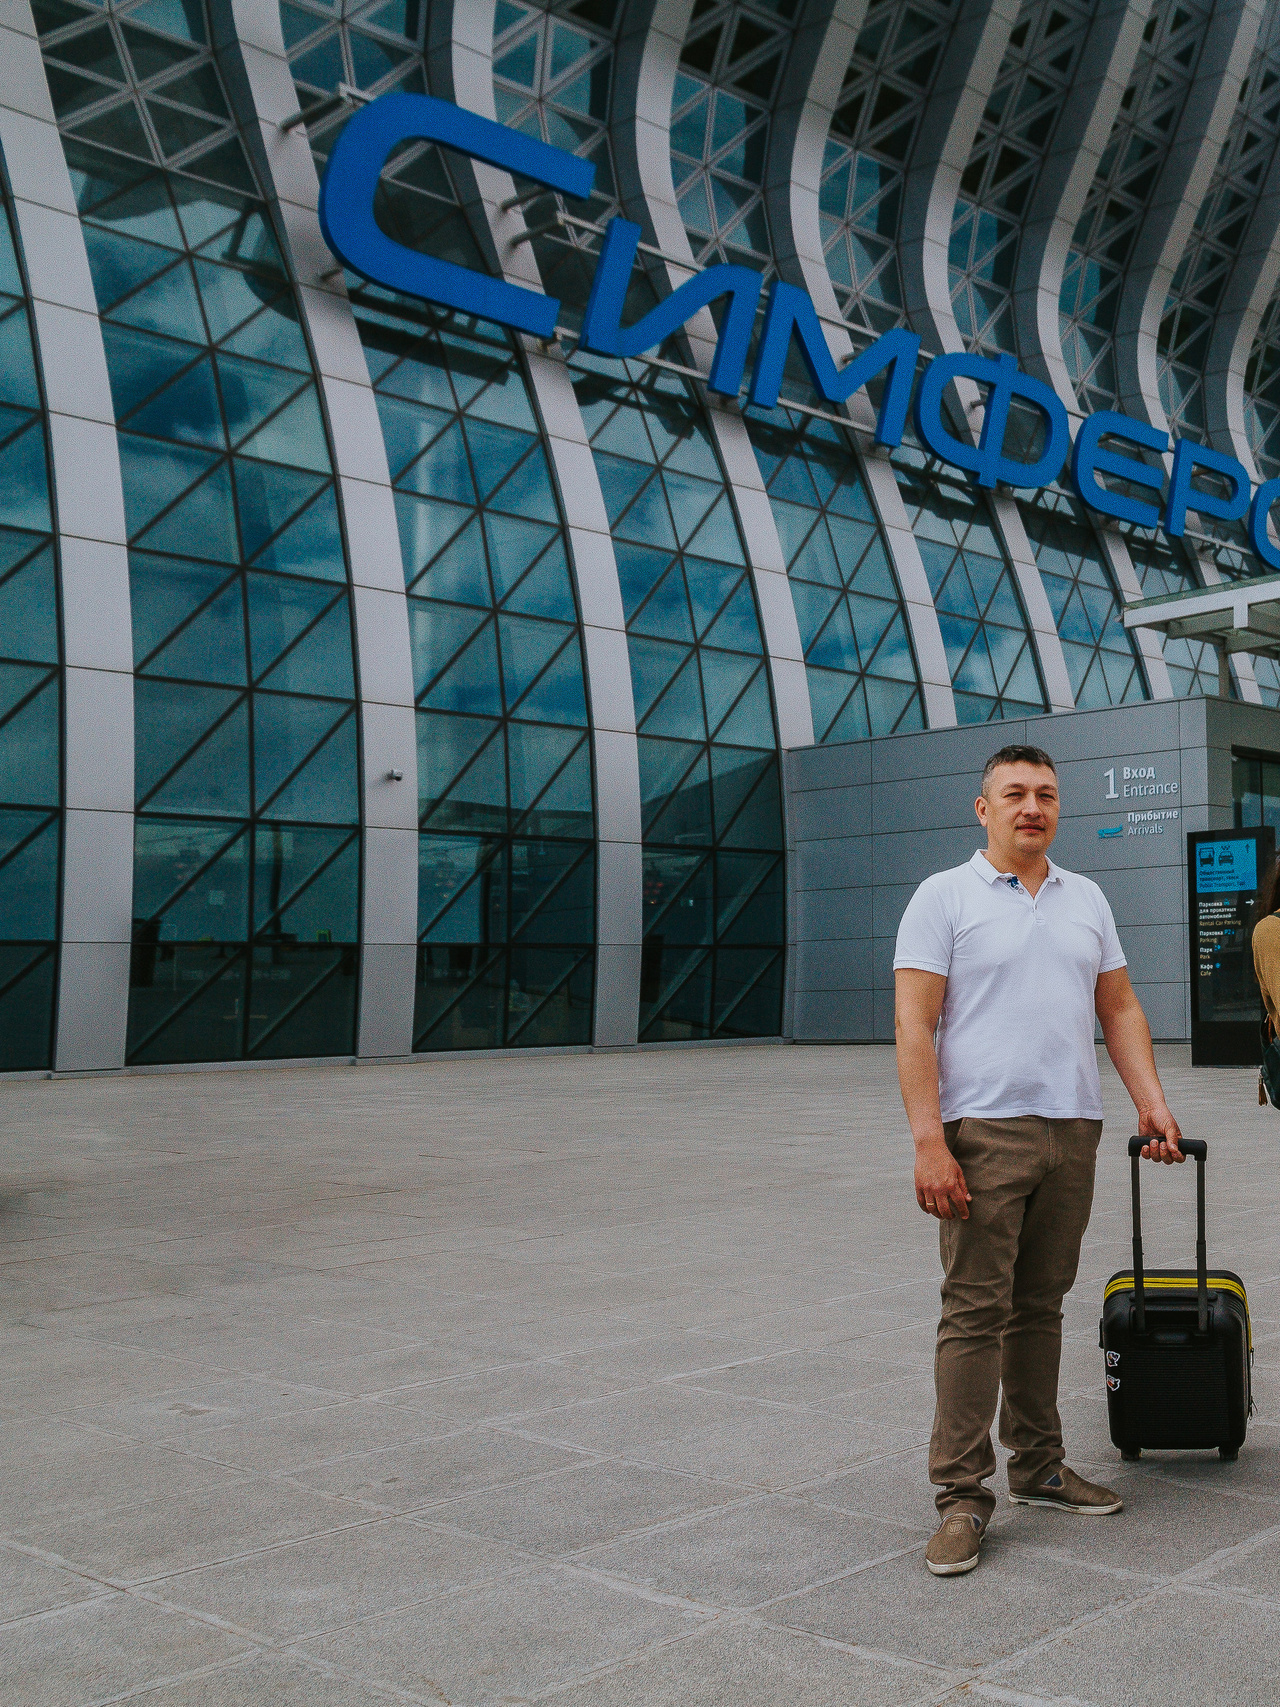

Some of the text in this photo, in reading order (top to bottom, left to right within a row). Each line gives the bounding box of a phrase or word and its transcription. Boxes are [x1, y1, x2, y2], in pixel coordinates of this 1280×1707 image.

[1123, 767, 1155, 779] Вход
[1104, 767, 1119, 799] 1
[1123, 782, 1178, 797] Entrance
[1127, 810, 1178, 823] Прибытие
[1128, 823, 1163, 836] Arrivals
